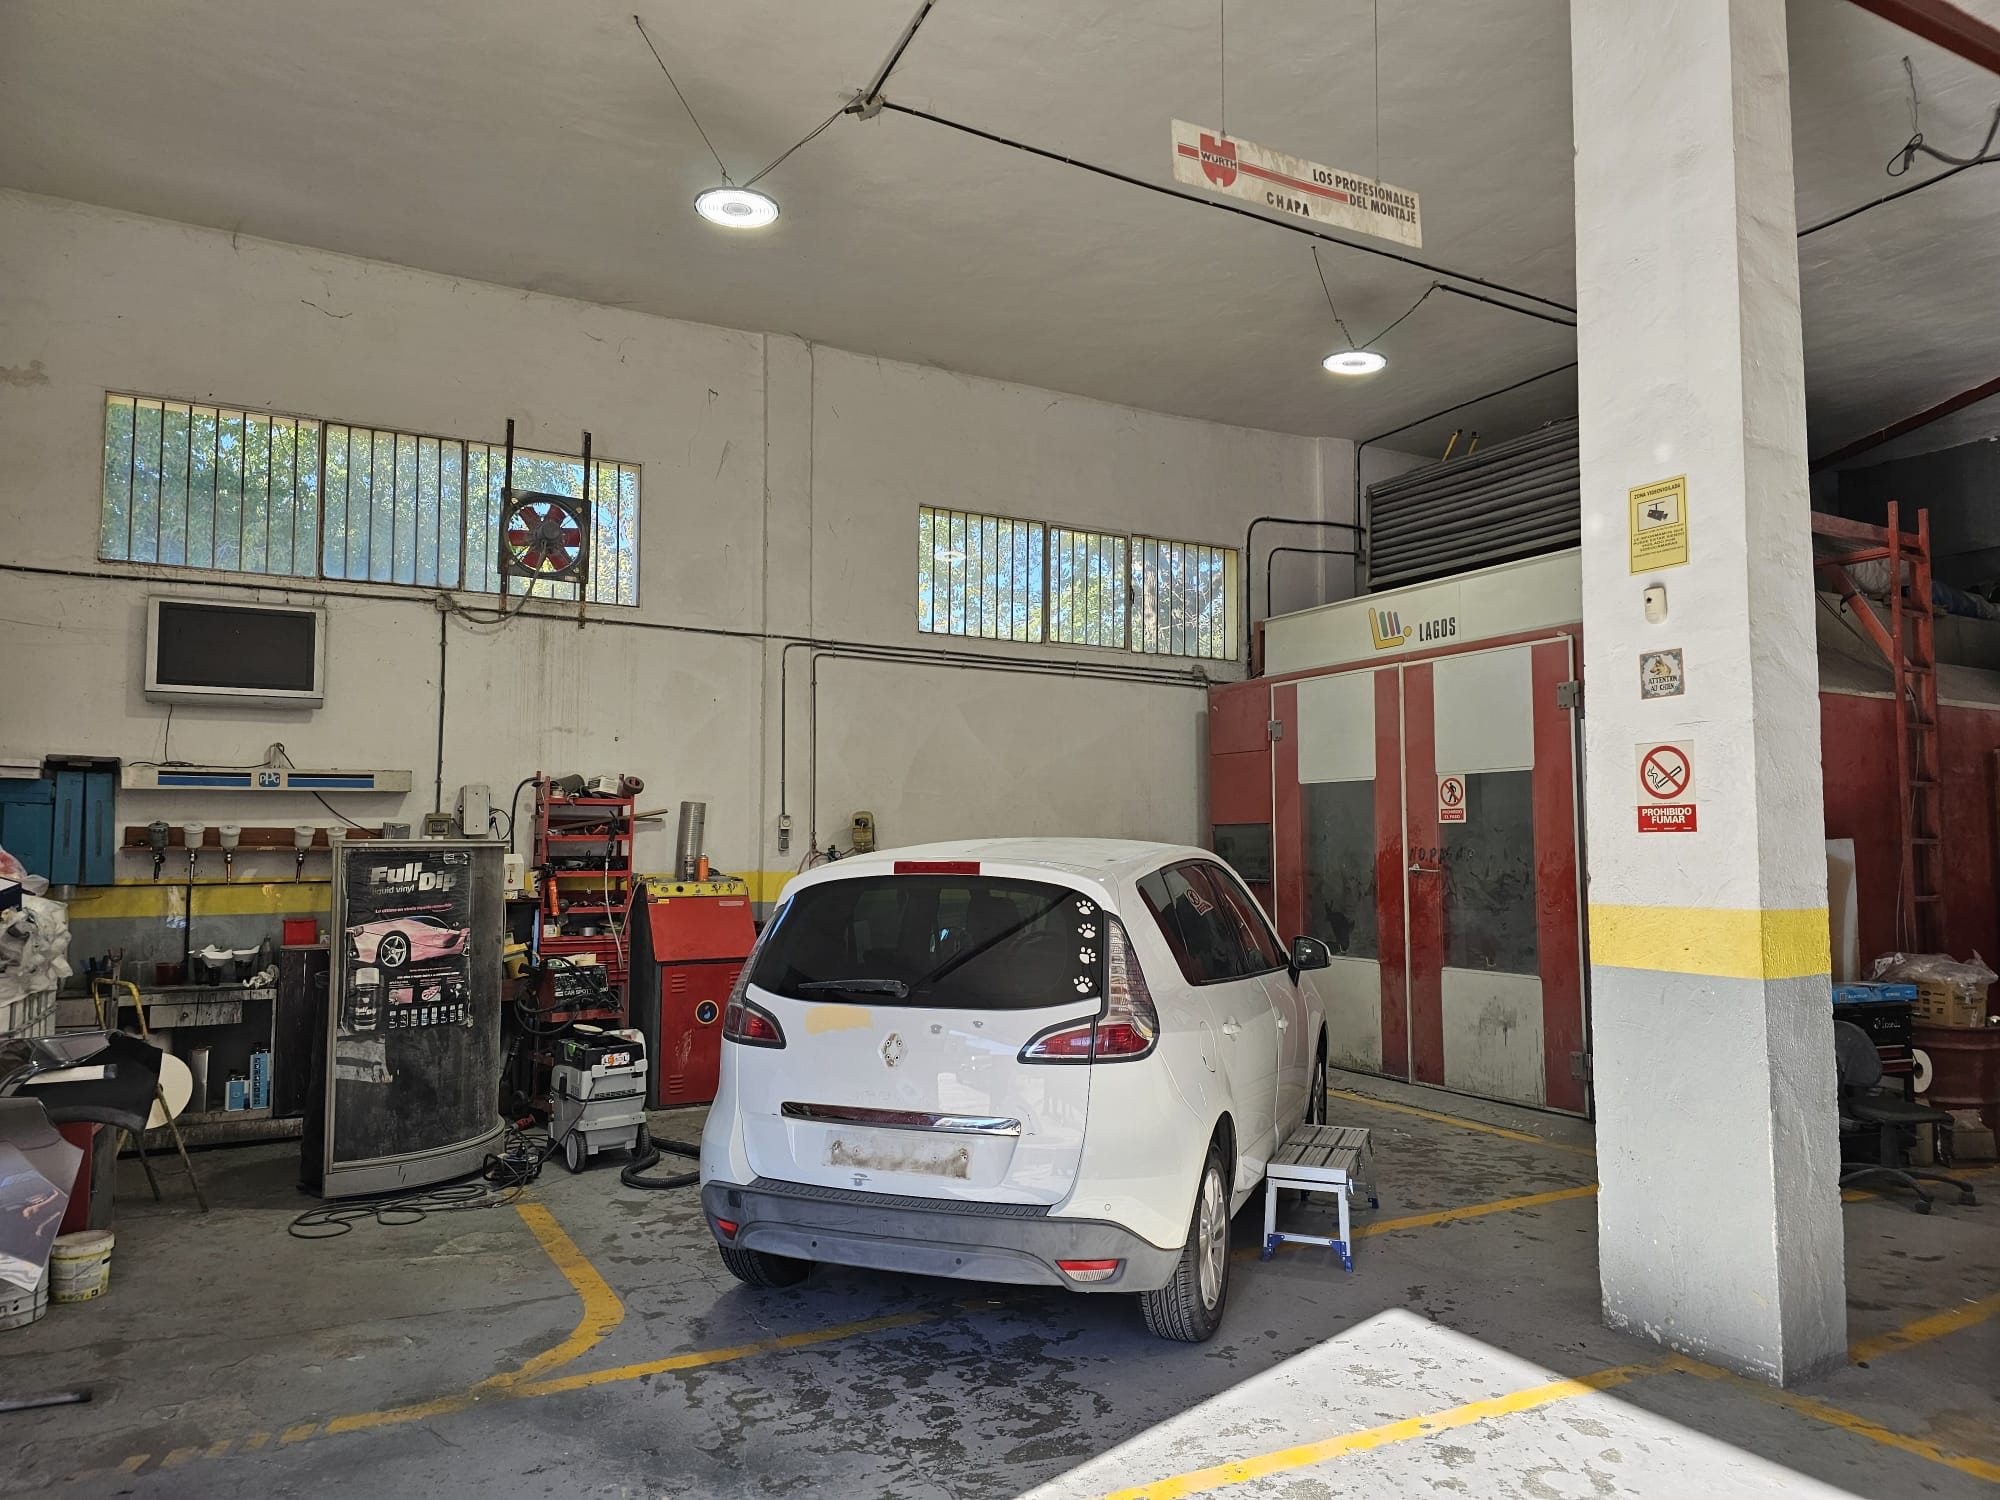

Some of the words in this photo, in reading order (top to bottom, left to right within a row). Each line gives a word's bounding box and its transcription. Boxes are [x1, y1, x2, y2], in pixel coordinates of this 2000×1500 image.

[1313, 169, 1333, 186] LOS
[1335, 175, 1416, 210] PROFESIONALES
[1266, 191, 1310, 217] CHAPA
[1349, 194, 1368, 210] DEL
[1371, 199, 1416, 224] MONTAJE
[1419, 616, 1456, 642] LAGOS
[1648, 675, 1678, 685] ATTENTION
[1660, 683, 1675, 691] CHIEN
[260, 772, 280, 785] PPG
[1641, 807, 1692, 817] PROHIBIDO
[1651, 815, 1686, 824] FUMAR
[369, 862, 423, 886] Full
[419, 870, 456, 892] Dip
[371, 885, 395, 896] liquid
[396, 884, 416, 894] vinyl
